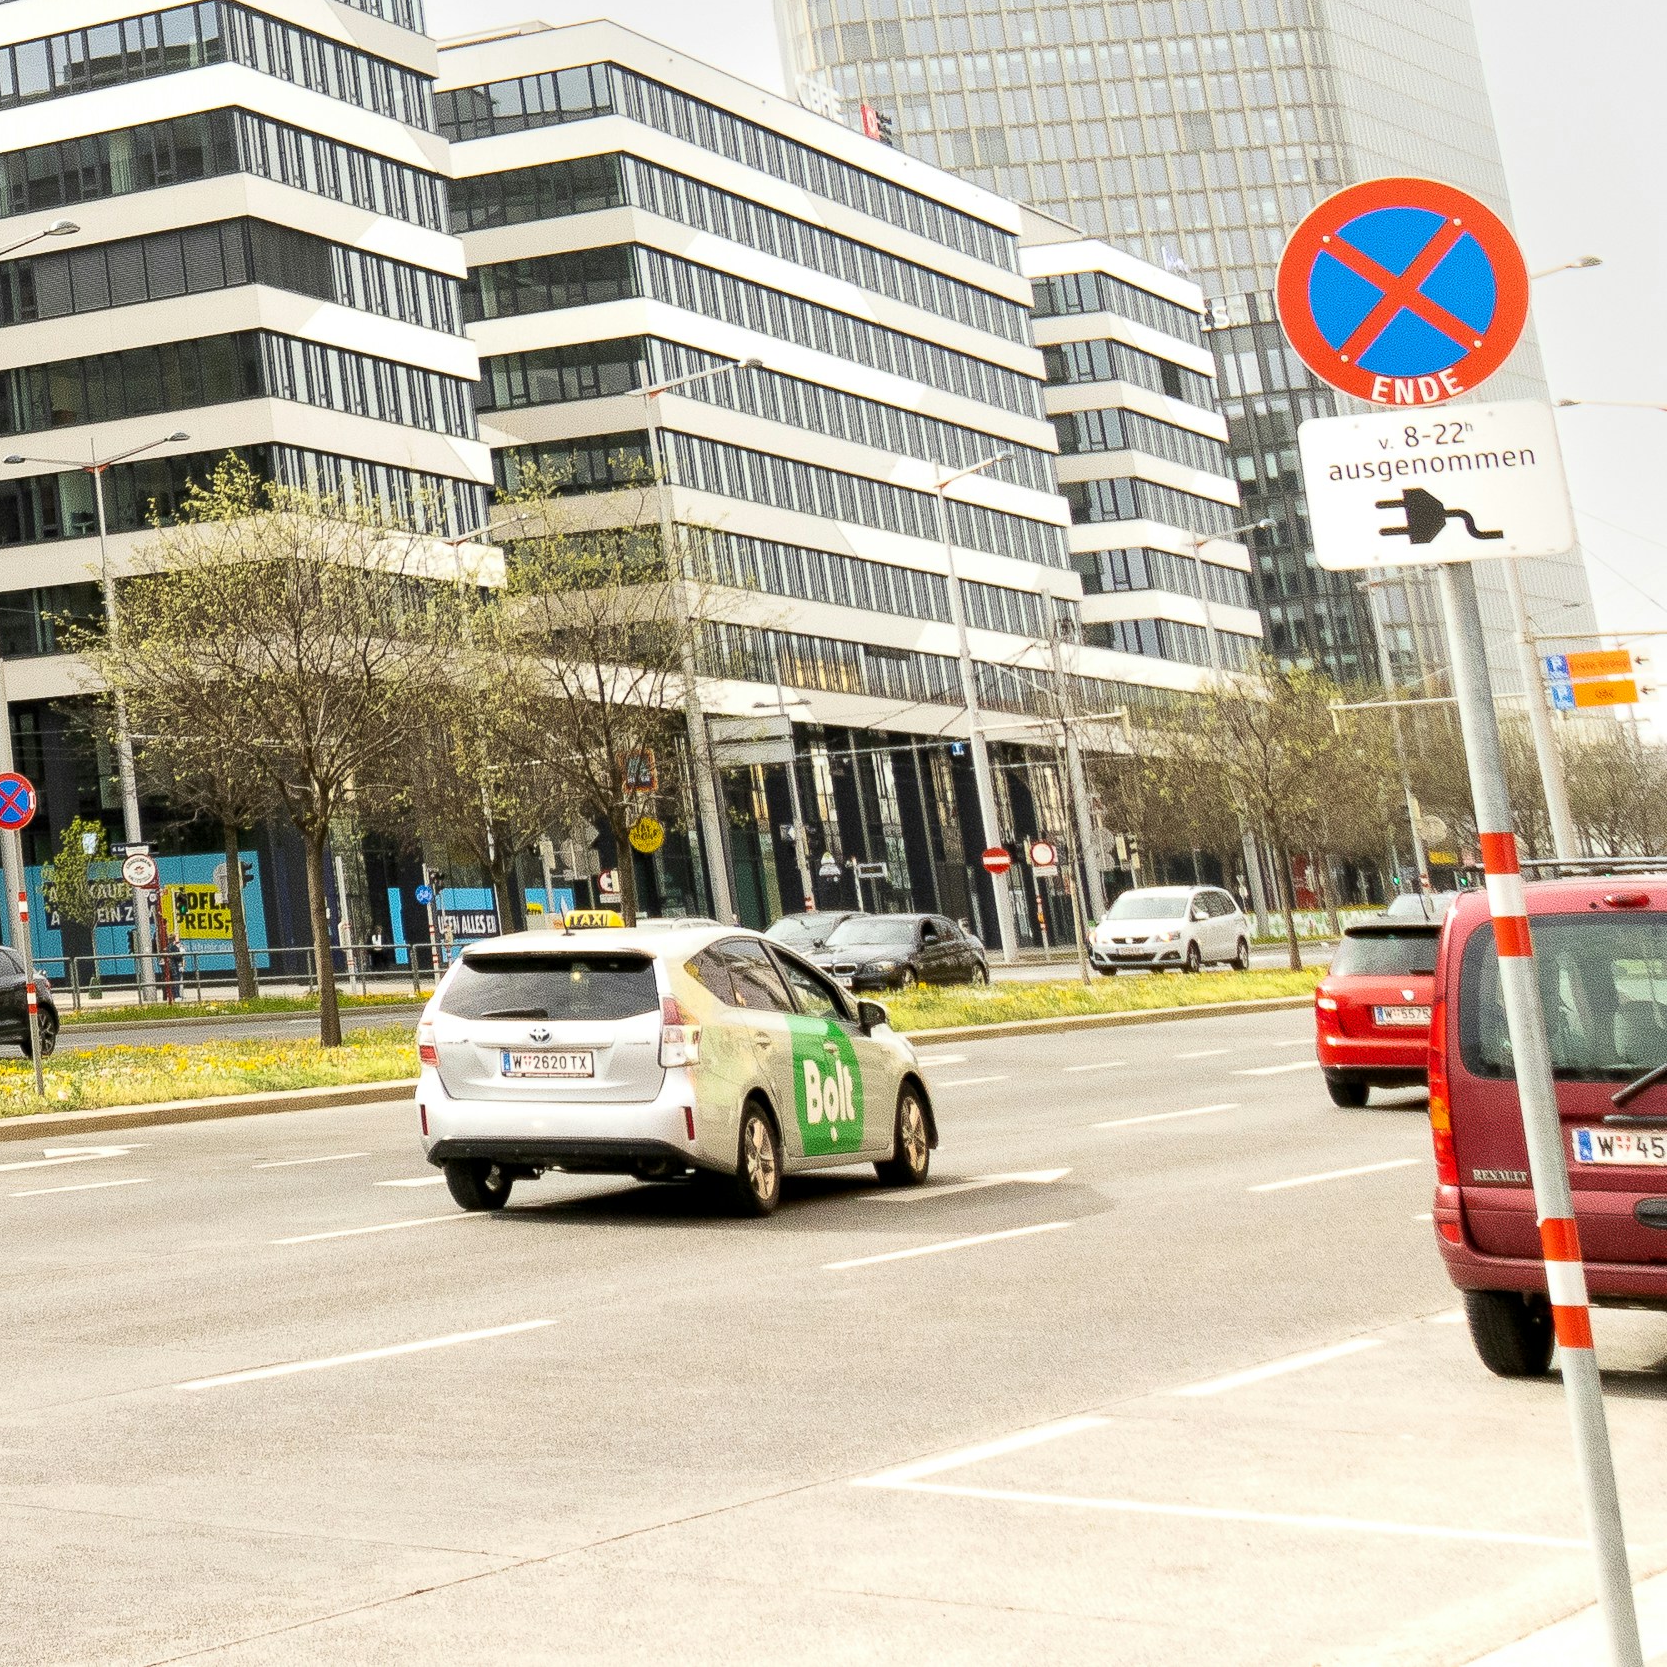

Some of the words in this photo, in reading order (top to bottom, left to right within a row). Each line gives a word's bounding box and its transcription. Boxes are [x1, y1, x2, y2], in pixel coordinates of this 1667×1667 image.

[1371, 367, 1464, 405] ENDE
[1378, 438, 1394, 450] v.
[1328, 448, 1536, 482] ausgenommen
[461, 914, 486, 934] ALLES
[571, 913, 608, 927] TAXI
[512, 1055, 522, 1069] W
[533, 1055, 567, 1070] 2620
[570, 1055, 587, 1069] TX
[803, 1058, 856, 1125] Bolt
[1597, 1136, 1614, 1158] W
[1473, 1169, 1528, 1183] RENAULT
